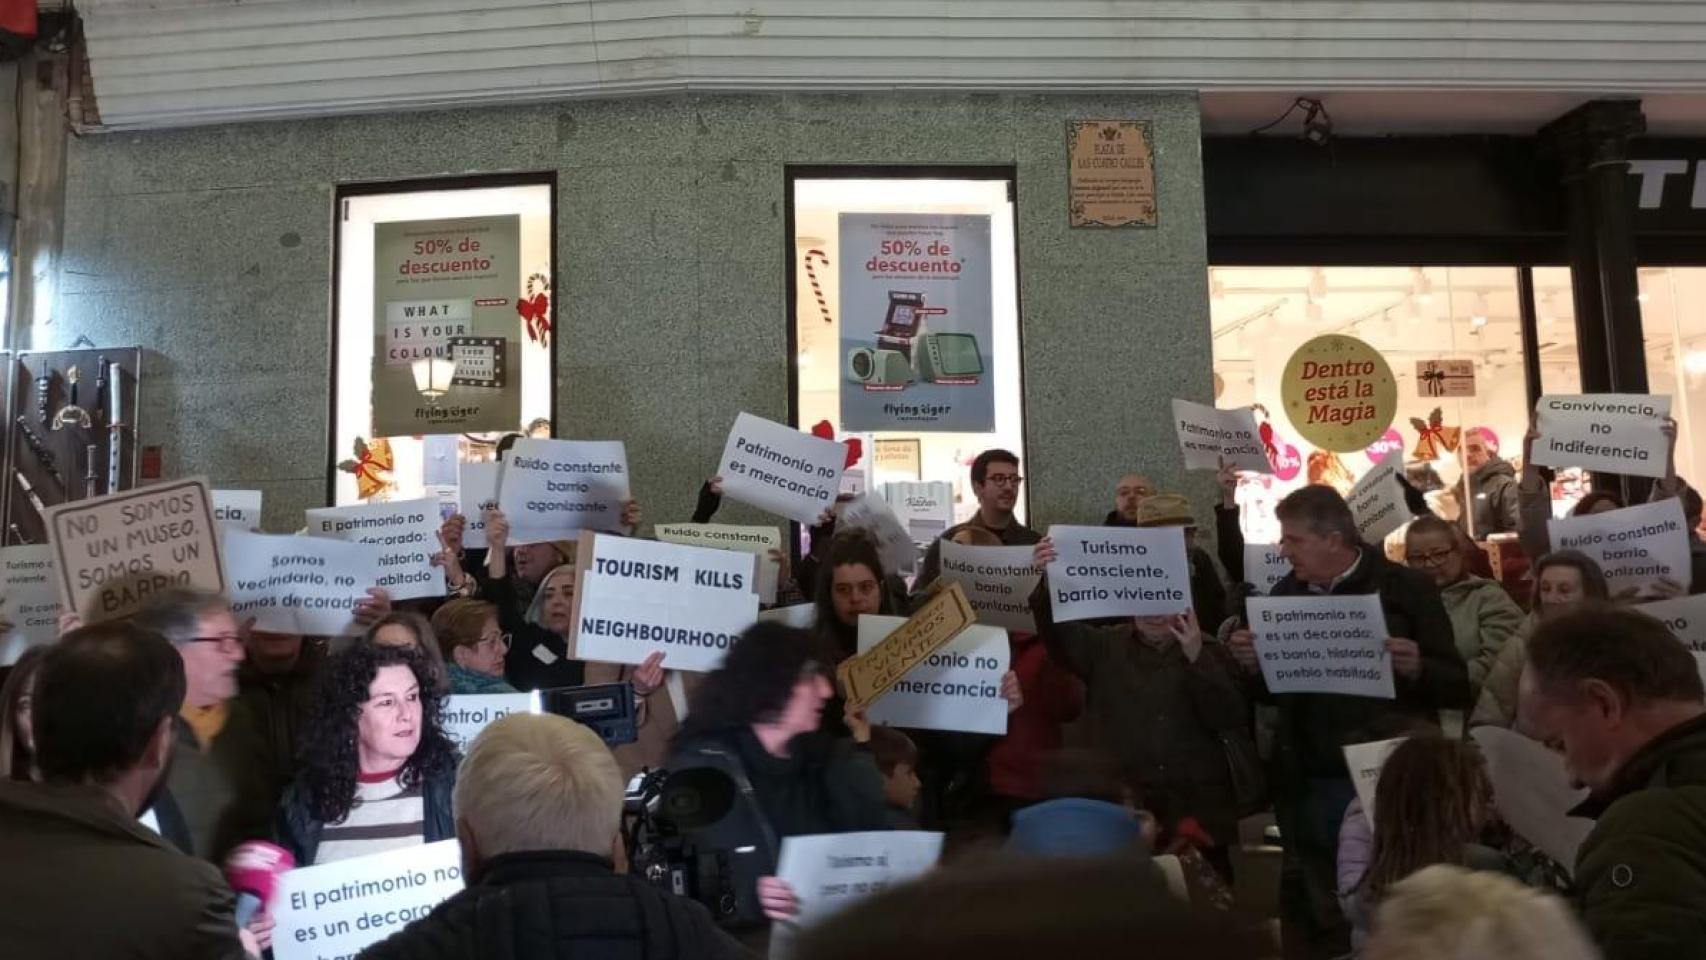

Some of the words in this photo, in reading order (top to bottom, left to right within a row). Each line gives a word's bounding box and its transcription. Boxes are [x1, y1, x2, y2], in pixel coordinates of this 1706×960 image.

[413, 239, 453, 256] 50%
[458, 236, 481, 253] de
[880, 240, 921, 256] 50%
[927, 239, 951, 256] de
[404, 304, 450, 318] WHAT
[393, 328, 411, 339] IS
[421, 323, 466, 337] YOUR
[1301, 359, 1375, 381] Dentro
[1305, 380, 1350, 402] está
[1354, 380, 1374, 398] la
[884, 403, 918, 416] flying
[1307, 401, 1377, 426] Magia
[1549, 400, 1658, 418] Convivencia,
[1234, 430, 1252, 440] no
[1590, 423, 1612, 435] no
[735, 436, 813, 474] Patrimonio
[817, 464, 835, 479] no
[1550, 438, 1649, 461] indiferencia
[513, 456, 550, 471] Ruido
[730, 459, 746, 474] es
[546, 480, 590, 493] barrio
[526, 500, 609, 513] agonizante
[66, 513, 99, 540] NO
[120, 492, 195, 526] SOMOS
[321, 520, 333, 532] El
[335, 514, 406, 532] patrimonio
[408, 512, 425, 524] no
[664, 526, 701, 538] Ruido
[86, 536, 118, 558] UN
[1080, 540, 1148, 556] Turismo
[1560, 535, 1602, 548] Ruido
[271, 553, 326, 568] Somos
[1602, 547, 1649, 561] barrio
[79, 553, 154, 590] SOMOS
[171, 541, 200, 564] UN
[595, 557, 680, 584] TOURISM
[694, 568, 744, 590] KILLS
[1066, 563, 1169, 580] consciente,
[1603, 564, 1671, 579] onizante
[333, 574, 356, 586] no
[975, 580, 1014, 596] barrio
[1057, 586, 1110, 604] barrio
[1112, 586, 1184, 602] viviente
[232, 596, 278, 613] omos
[1262, 611, 1273, 623] El
[1275, 610, 1347, 624] patrimonio
[1349, 610, 1367, 621] no
[1266, 631, 1280, 642] es
[1283, 630, 1301, 642] un
[871, 632, 938, 690] GENTE
[1264, 651, 1279, 662] es
[1327, 647, 1376, 660] historia
[974, 655, 999, 671] no
[1276, 666, 1323, 681] pueblo
[1324, 665, 1382, 681] habitado
[290, 892, 308, 911] El
[313, 868, 428, 911] patrimonio
[433, 864, 461, 888] no
[295, 926, 318, 942] es
[323, 918, 351, 938] un
